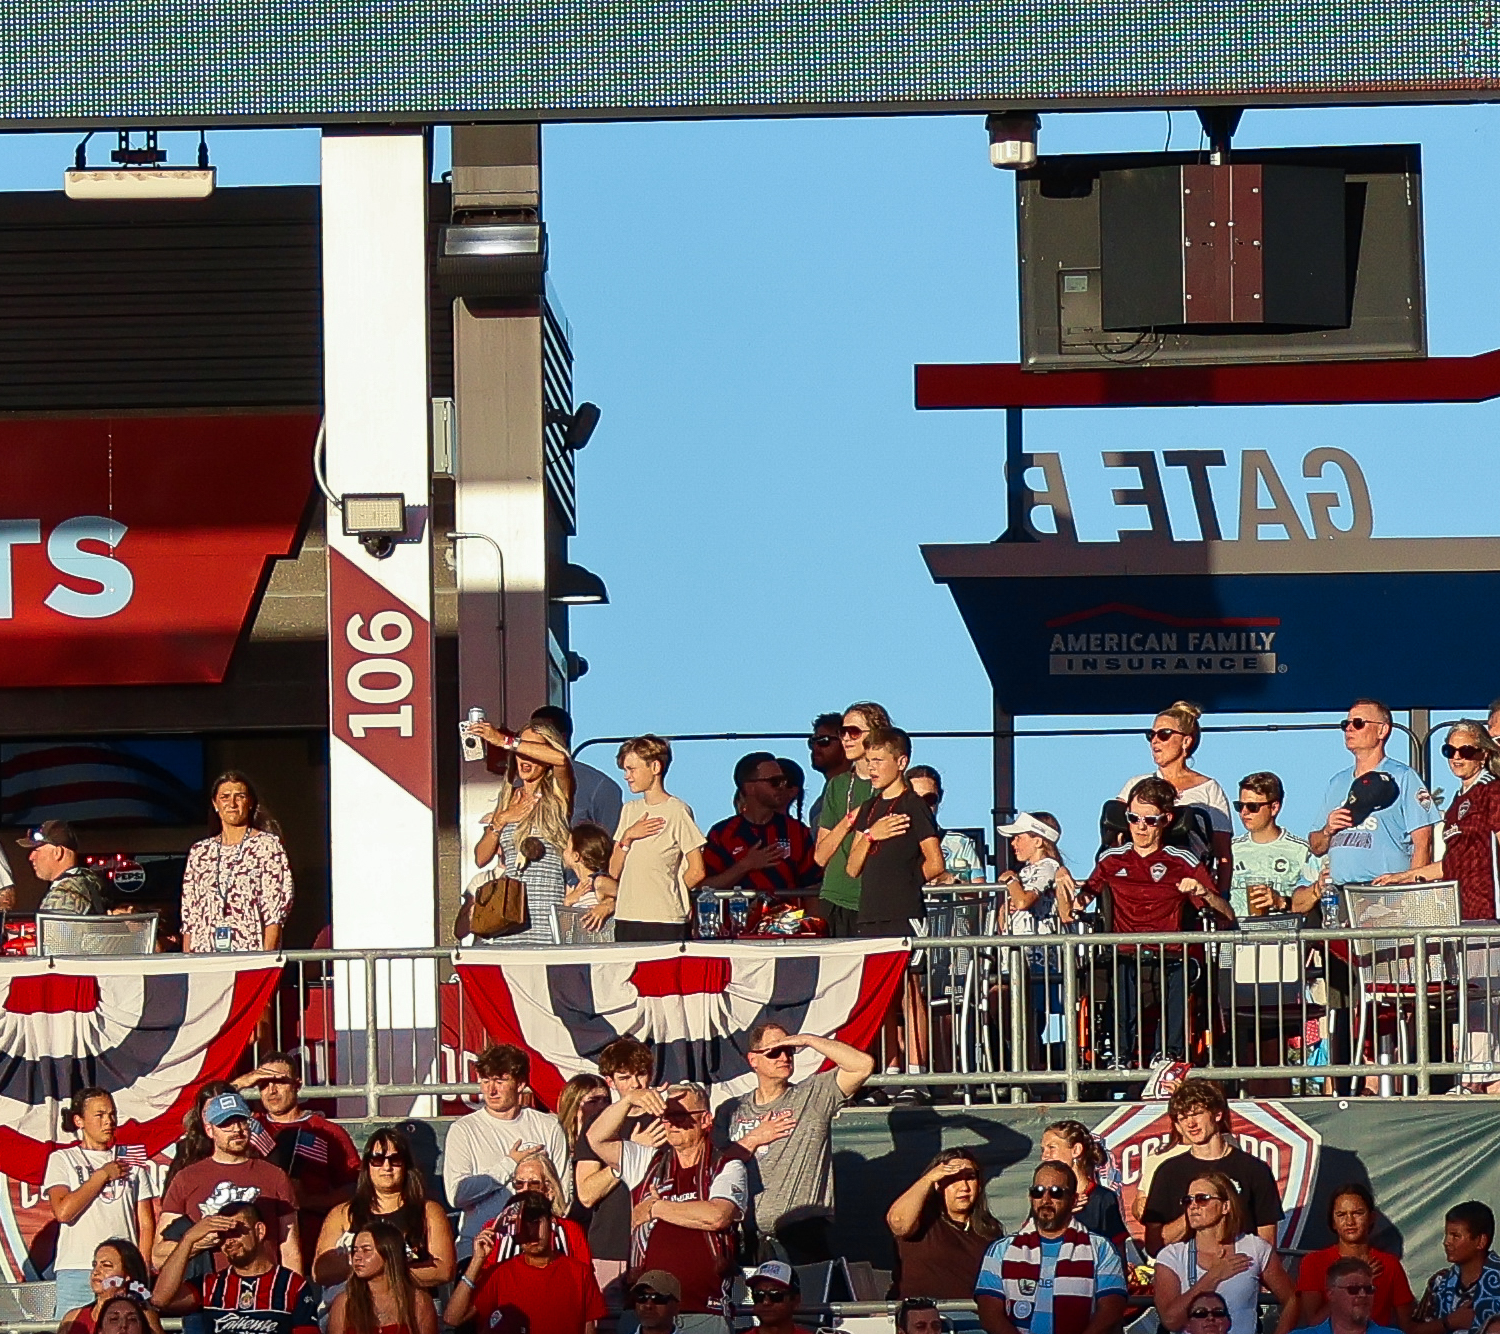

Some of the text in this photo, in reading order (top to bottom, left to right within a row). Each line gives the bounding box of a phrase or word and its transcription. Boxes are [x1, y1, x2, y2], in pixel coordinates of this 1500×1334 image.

[1049, 632, 1277, 653] AMERICAN FAMILY
[347, 607, 414, 739] 106
[1066, 657, 1260, 674] INSURANCE
